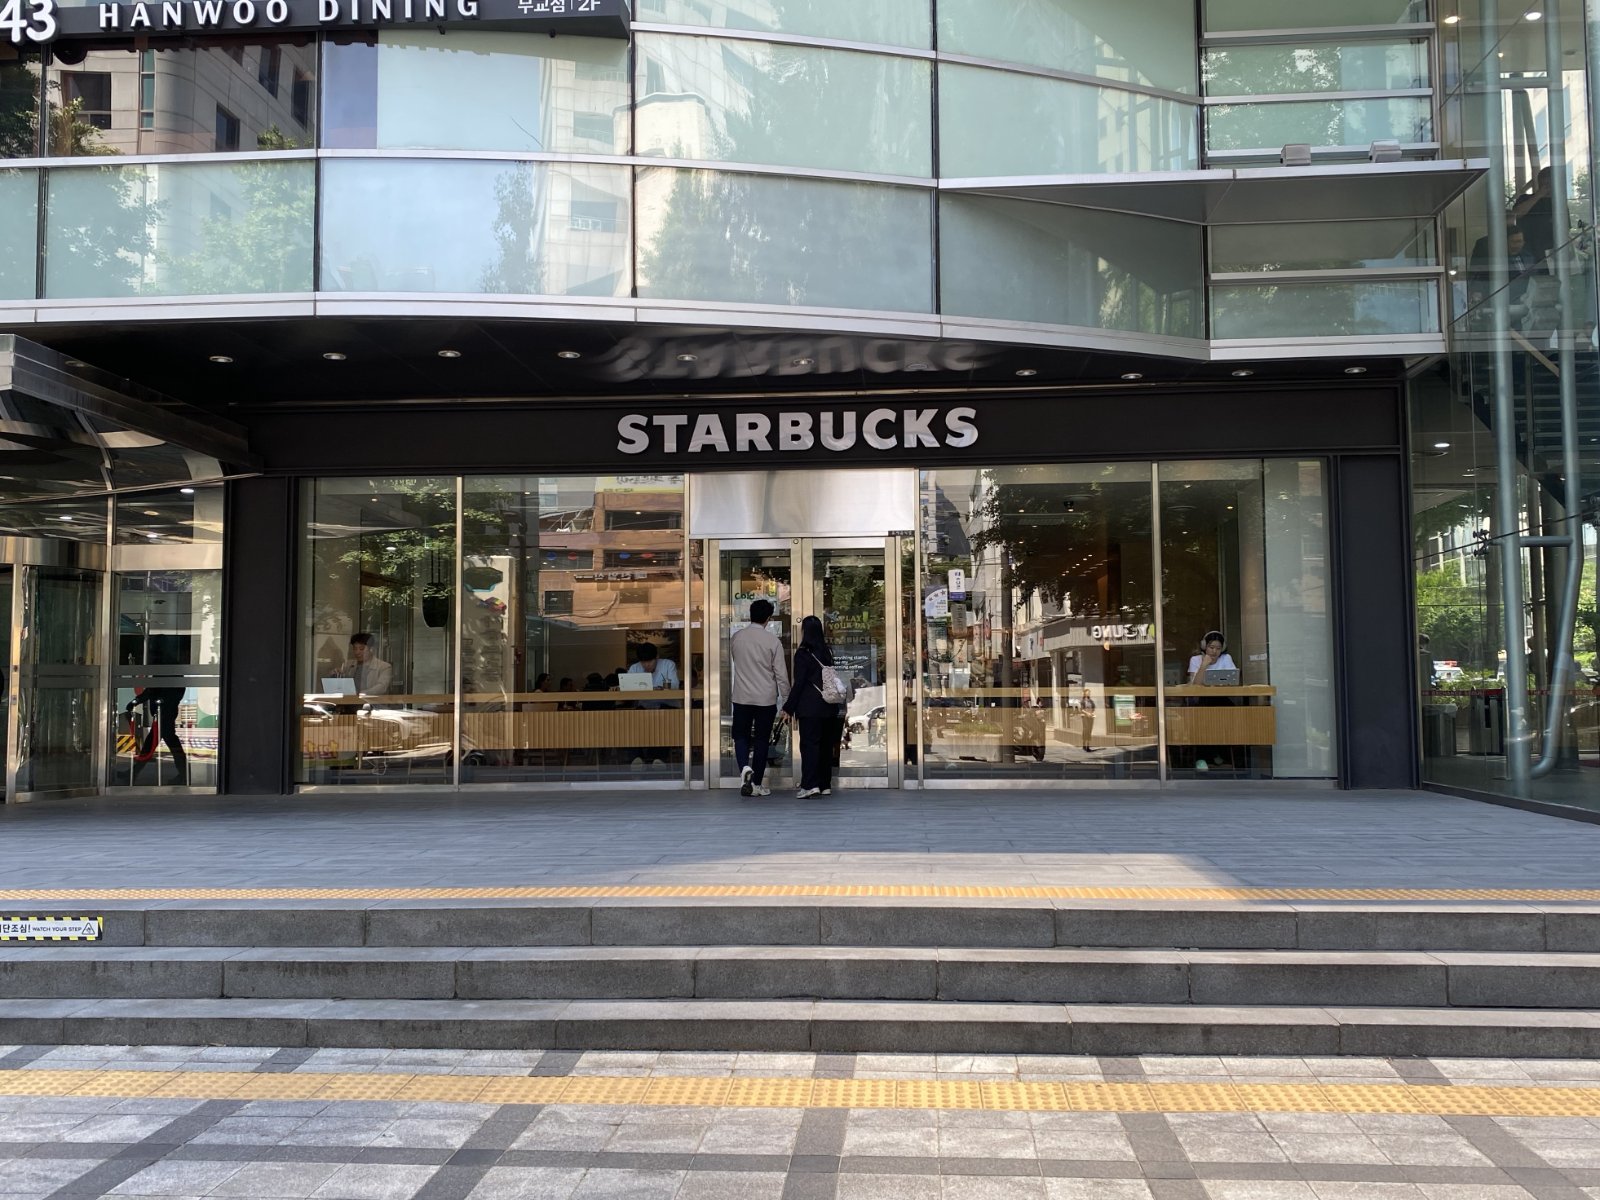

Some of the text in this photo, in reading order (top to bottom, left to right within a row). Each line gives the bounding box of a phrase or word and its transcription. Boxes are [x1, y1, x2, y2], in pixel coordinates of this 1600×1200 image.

[0, 0, 478, 43] 43 HANWOO DINING
[616, 406, 980, 454] STARBUCKS
[734, 592, 755, 600] Cold
[0, 923, 31, 934] 단조심!
